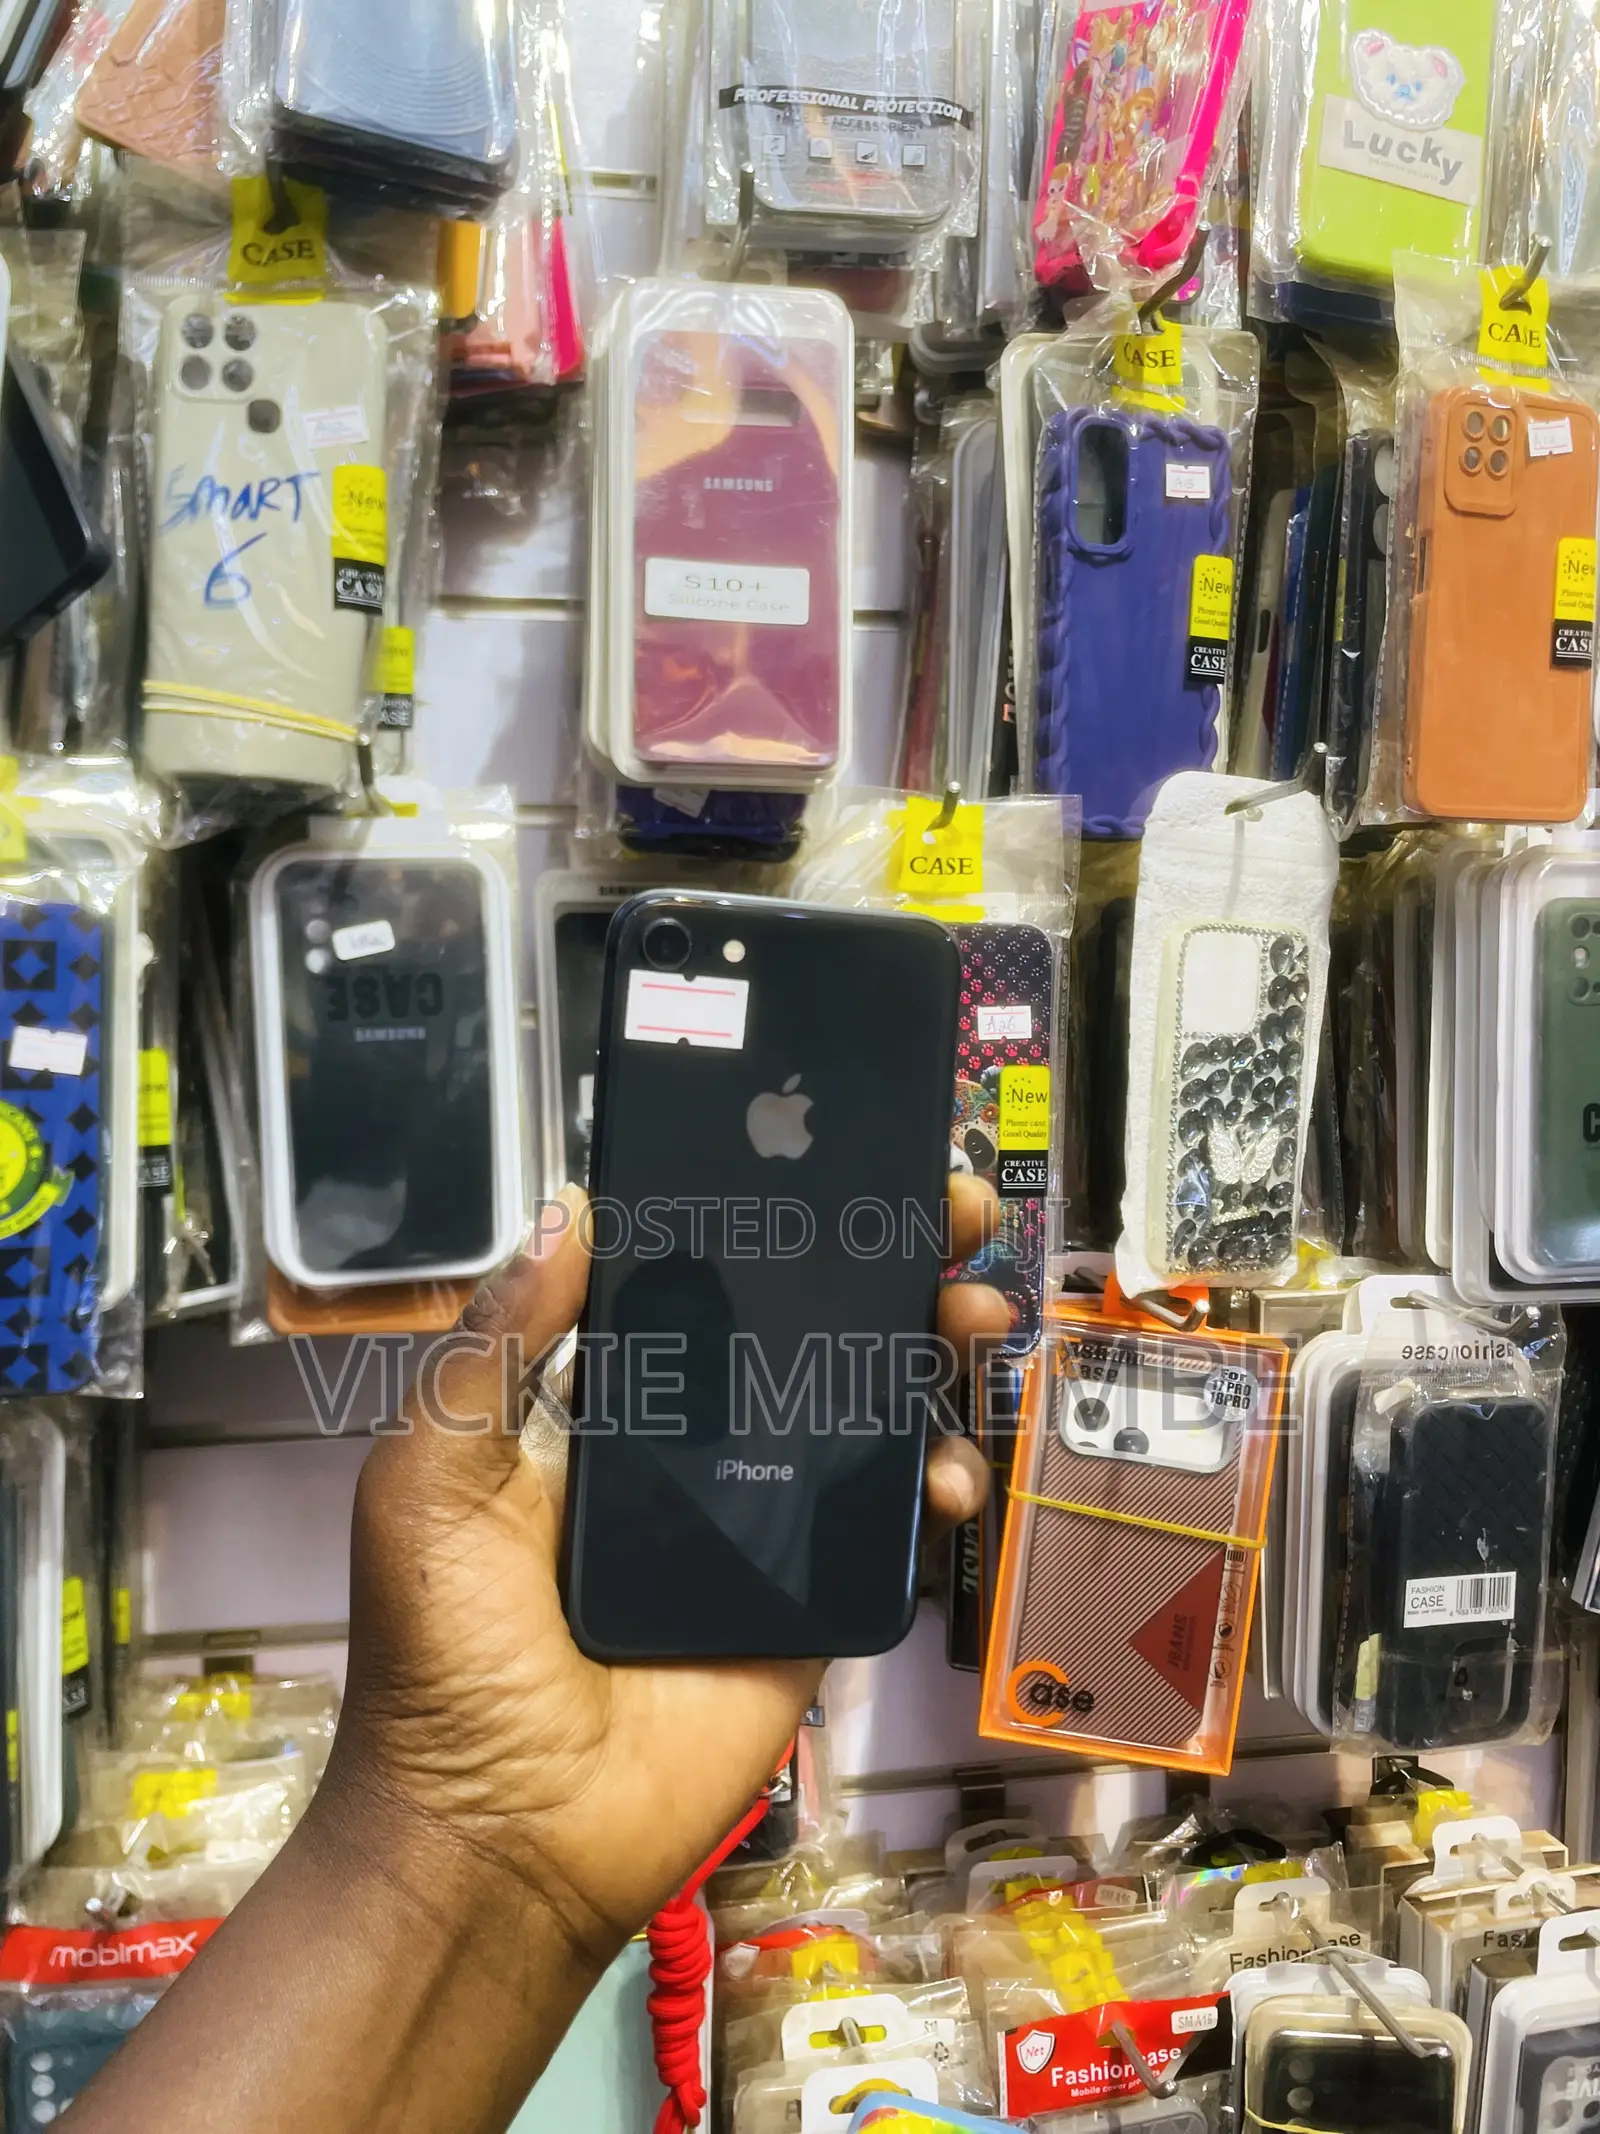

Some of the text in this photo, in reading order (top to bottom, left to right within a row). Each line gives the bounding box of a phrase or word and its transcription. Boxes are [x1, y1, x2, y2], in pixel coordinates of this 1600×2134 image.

[734, 88, 963, 121] PROFESSIONAL PROTECTION
[1344, 120, 1463, 186] Lucky
[242, 239, 316, 267] CASE
[1124, 342, 1176, 368] CASE
[704, 477, 773, 492] SAMSUNG
[159, 463, 320, 535] SMART
[204, 533, 267, 610] 6
[685, 575, 770, 592] S10+
[667, 593, 790, 612] Silicone Case
[910, 856, 974, 875] CASE
[327, 971, 443, 1021] CASE
[1011, 1088, 1047, 1104] New
[1006, 1118, 1046, 1127] Phone case
[1003, 1130, 1047, 1139] Good Quality
[1002, 1168, 1047, 1182] CASE
[1221, 1369, 1247, 1381] For
[1212, 1380, 1251, 1396] 17 PRO
[716, 1460, 793, 1481] iPhone
[1411, 1585, 1445, 1594] FASHION
[1411, 1595, 1444, 1609] CASE
[1007, 1660, 1094, 1727] Case
[1071, 2085, 1101, 2097] Mobile
[1102, 2083, 1126, 2093] cover
